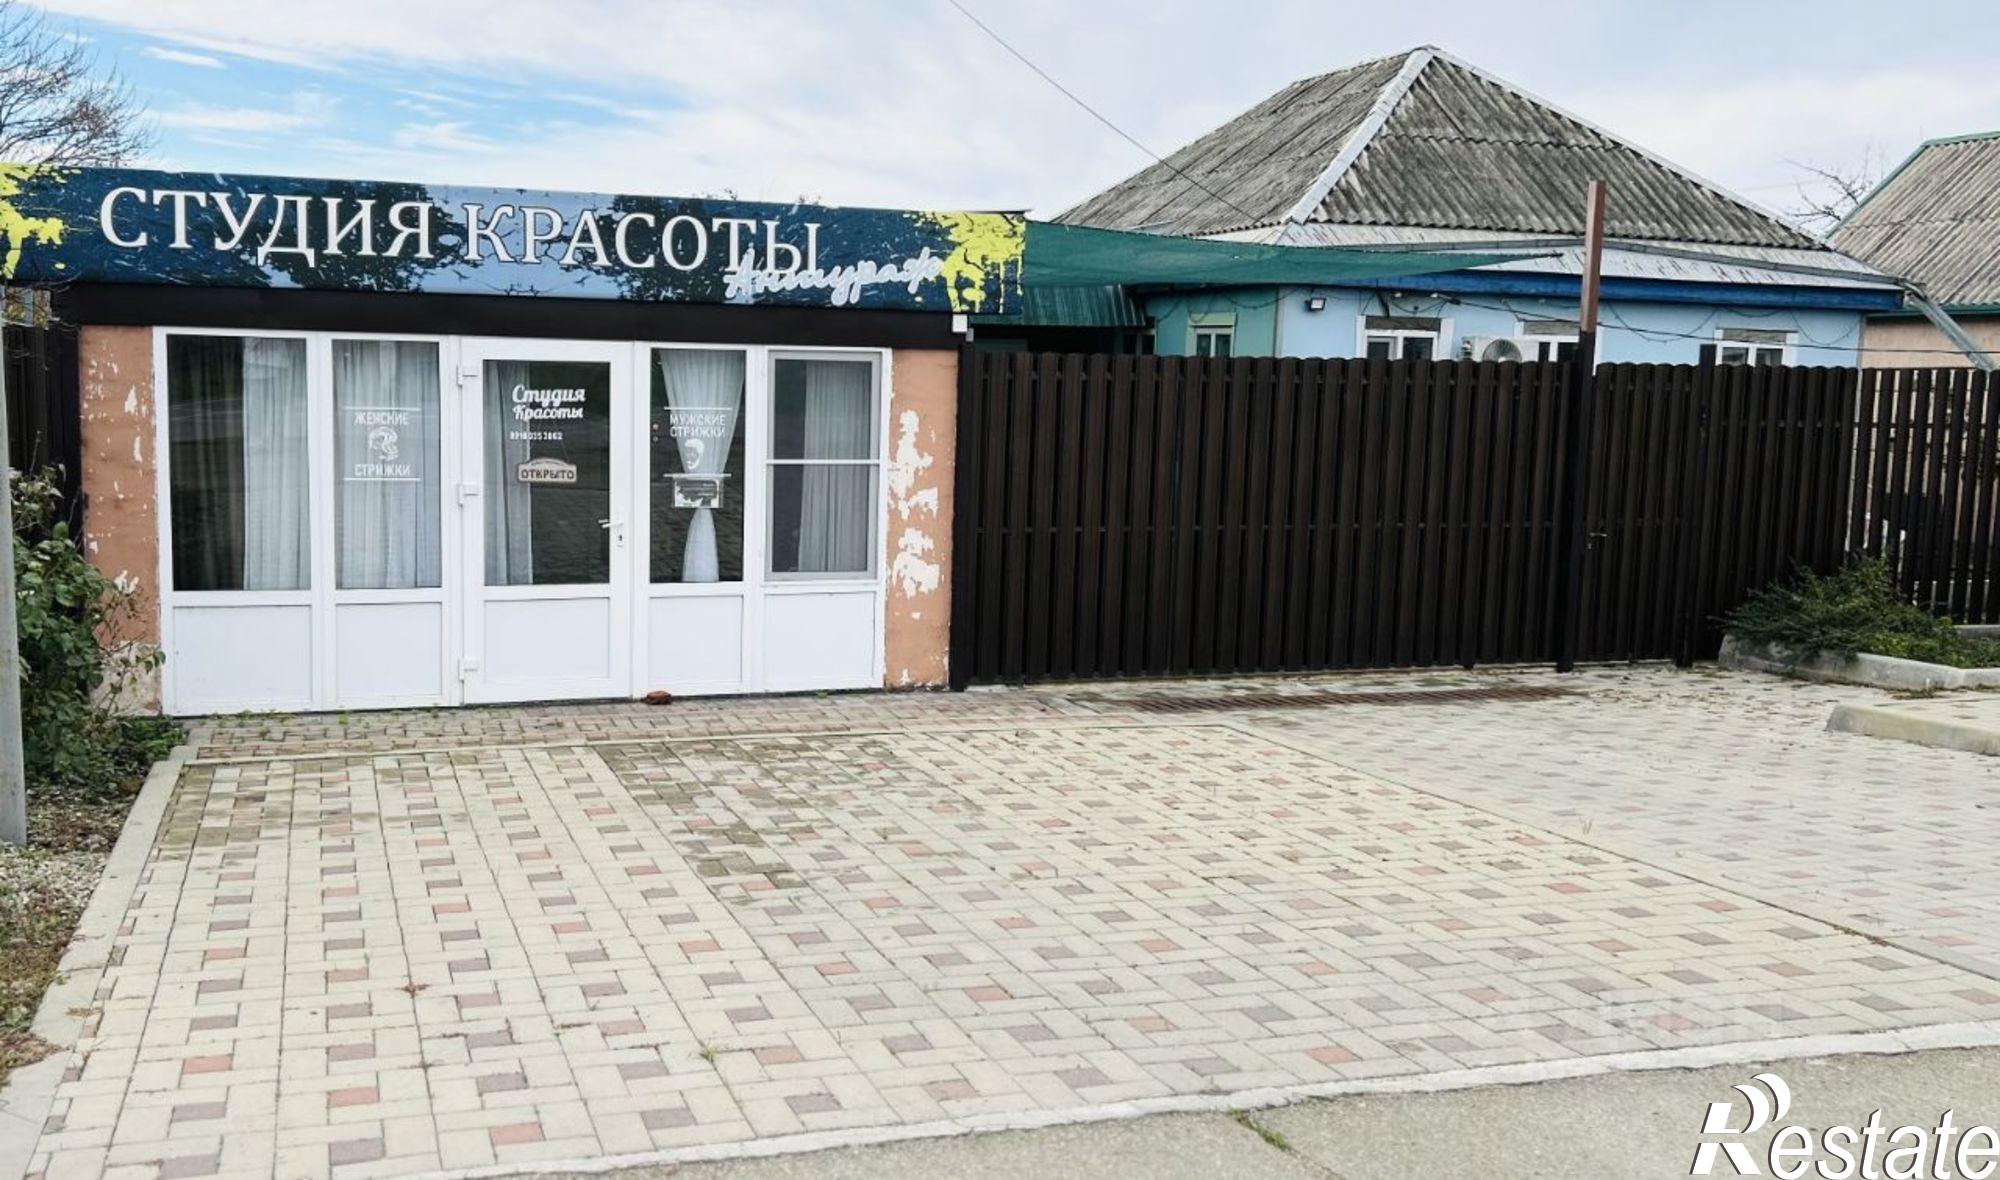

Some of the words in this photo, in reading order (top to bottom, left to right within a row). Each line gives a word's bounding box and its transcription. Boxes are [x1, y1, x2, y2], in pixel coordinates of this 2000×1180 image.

[101, 186, 436, 269] СТУДИЯ
[462, 202, 820, 272] КРАСОТЫ
[511, 384, 586, 408] Студия
[354, 411, 410, 426] ЖЕНСКИЕ
[511, 403, 584, 421] Красоты
[669, 413, 726, 426] МУЖСКИЕ
[669, 425, 726, 439] СТРИЖКИ
[354, 463, 411, 477] СТРИЖКИ
[520, 469, 575, 480] ОТКРЫТО
